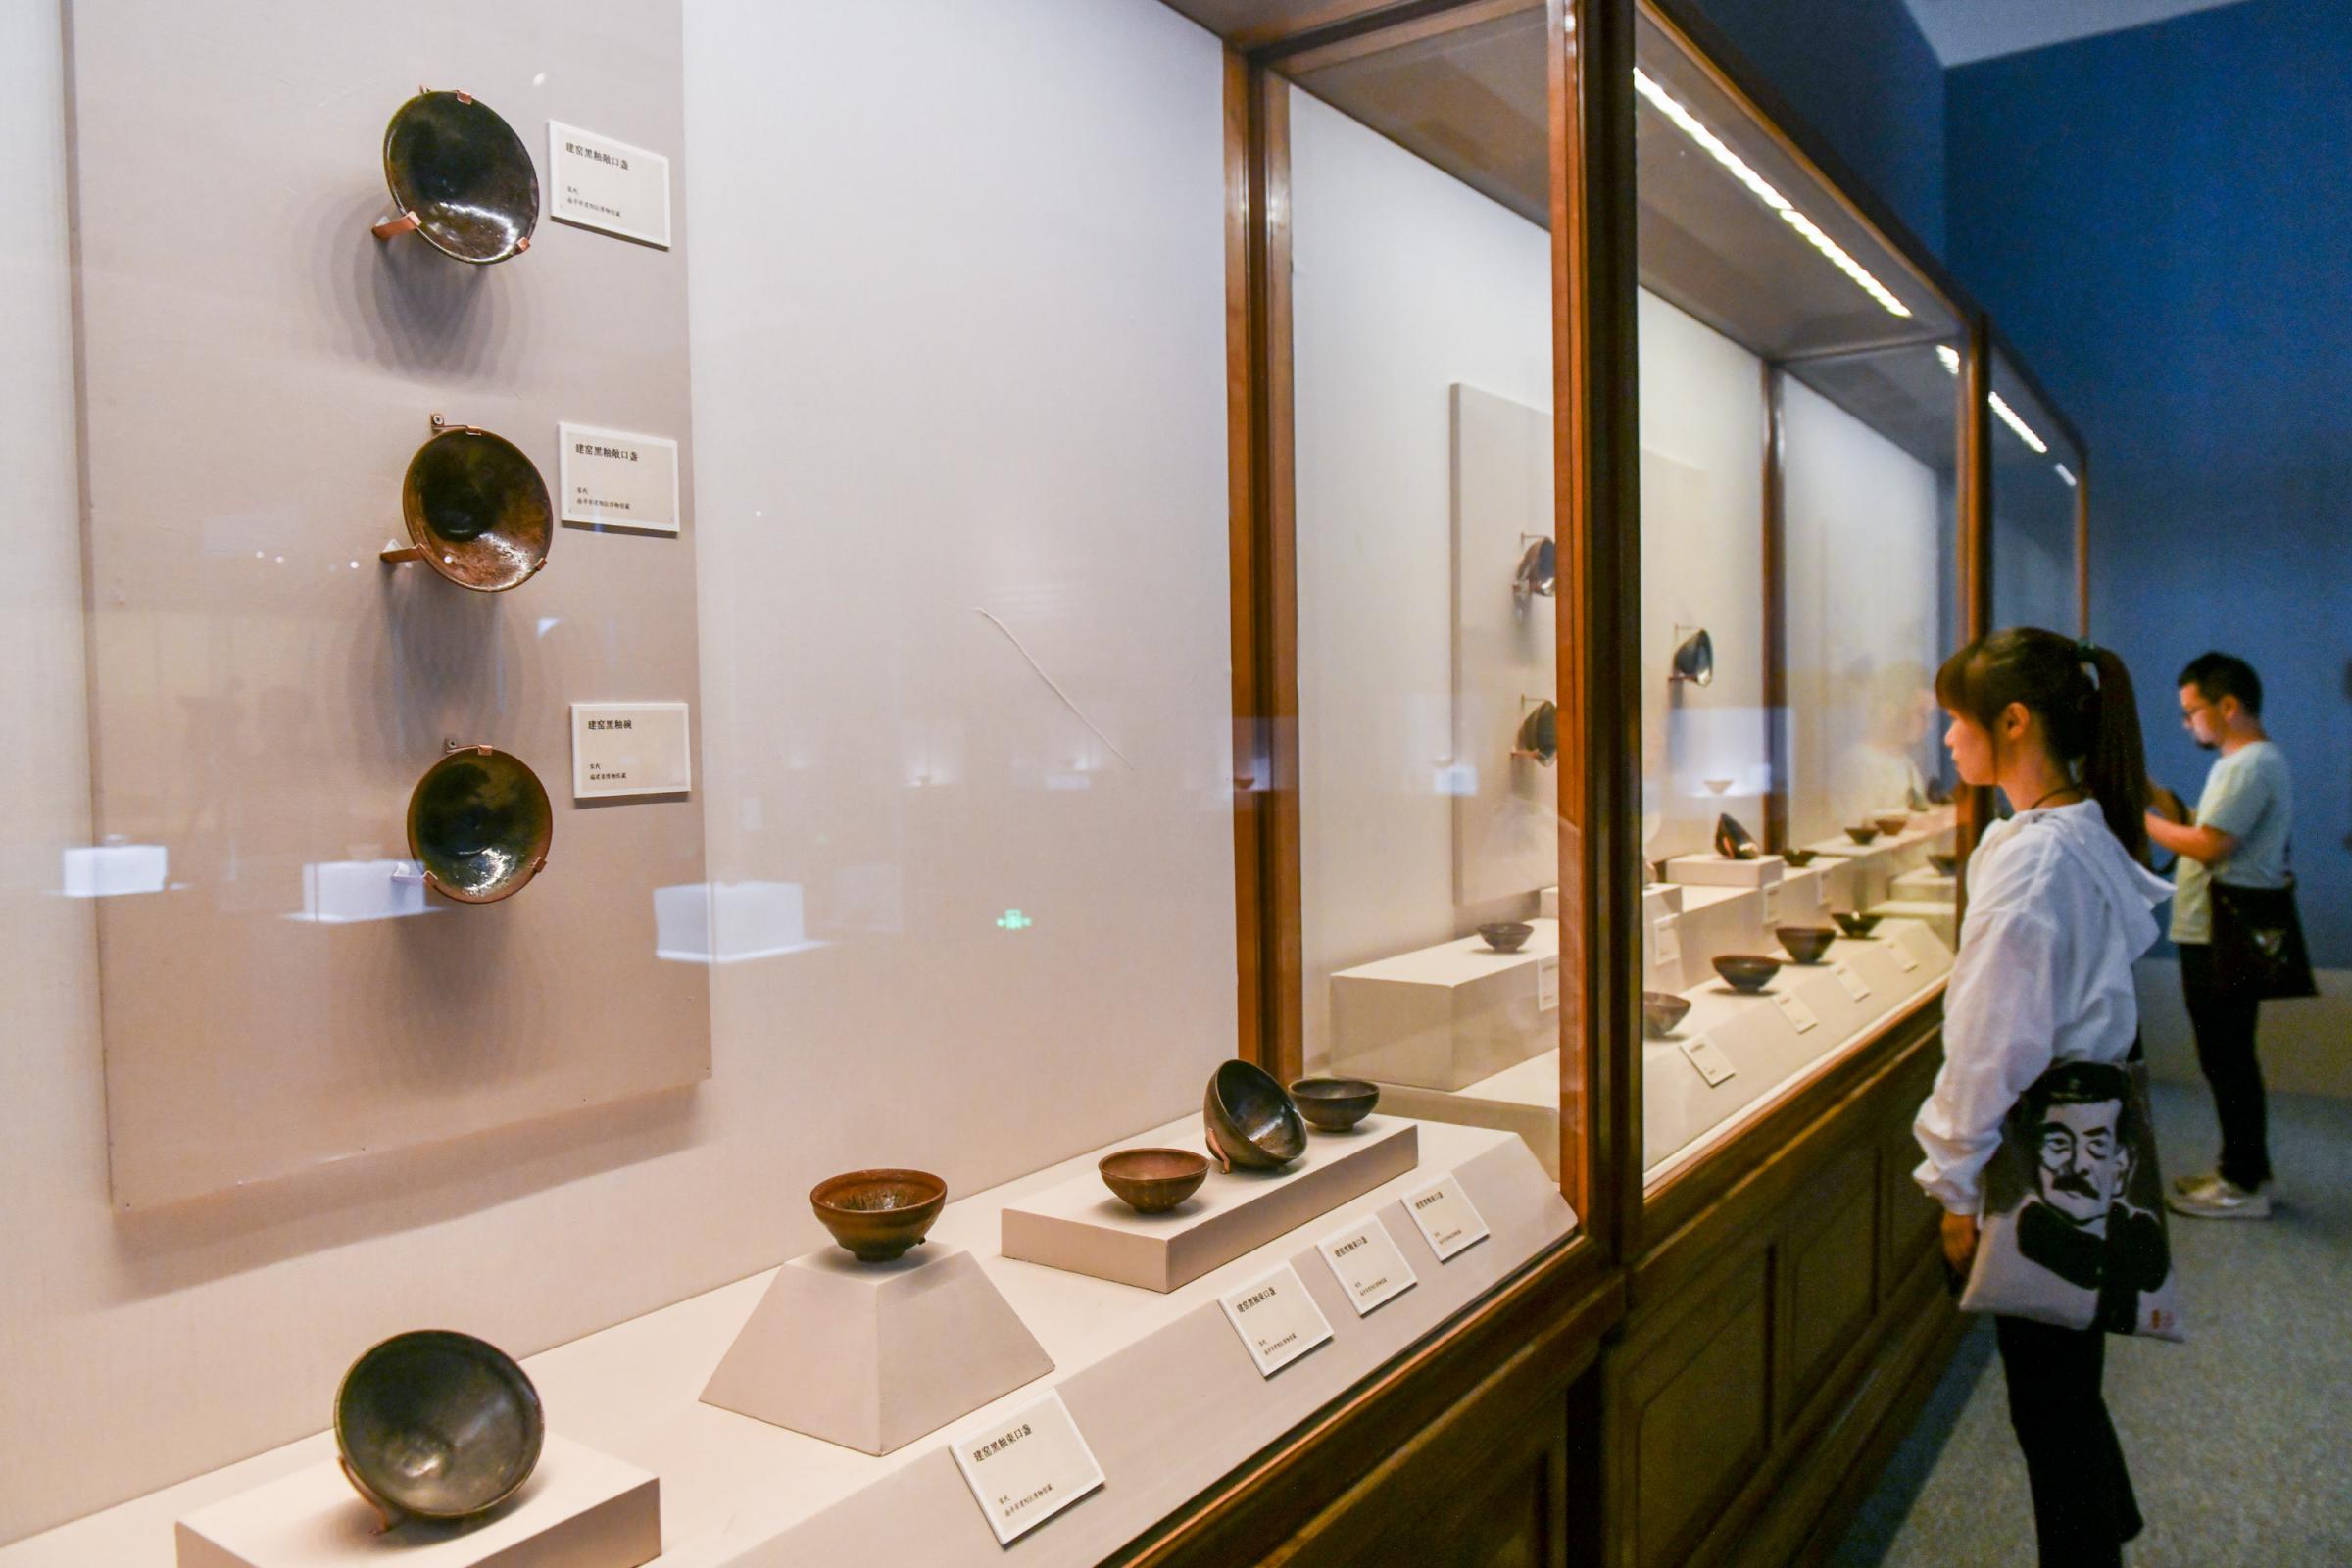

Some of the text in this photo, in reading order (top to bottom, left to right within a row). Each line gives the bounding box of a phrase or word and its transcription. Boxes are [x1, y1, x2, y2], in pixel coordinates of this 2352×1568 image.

[575, 443, 638, 462] 建窑黑釉敞口盏
[588, 719, 633, 730] 建窑黑釉碗
[973, 1423, 1033, 1462] 建窑黑釉束口盏
